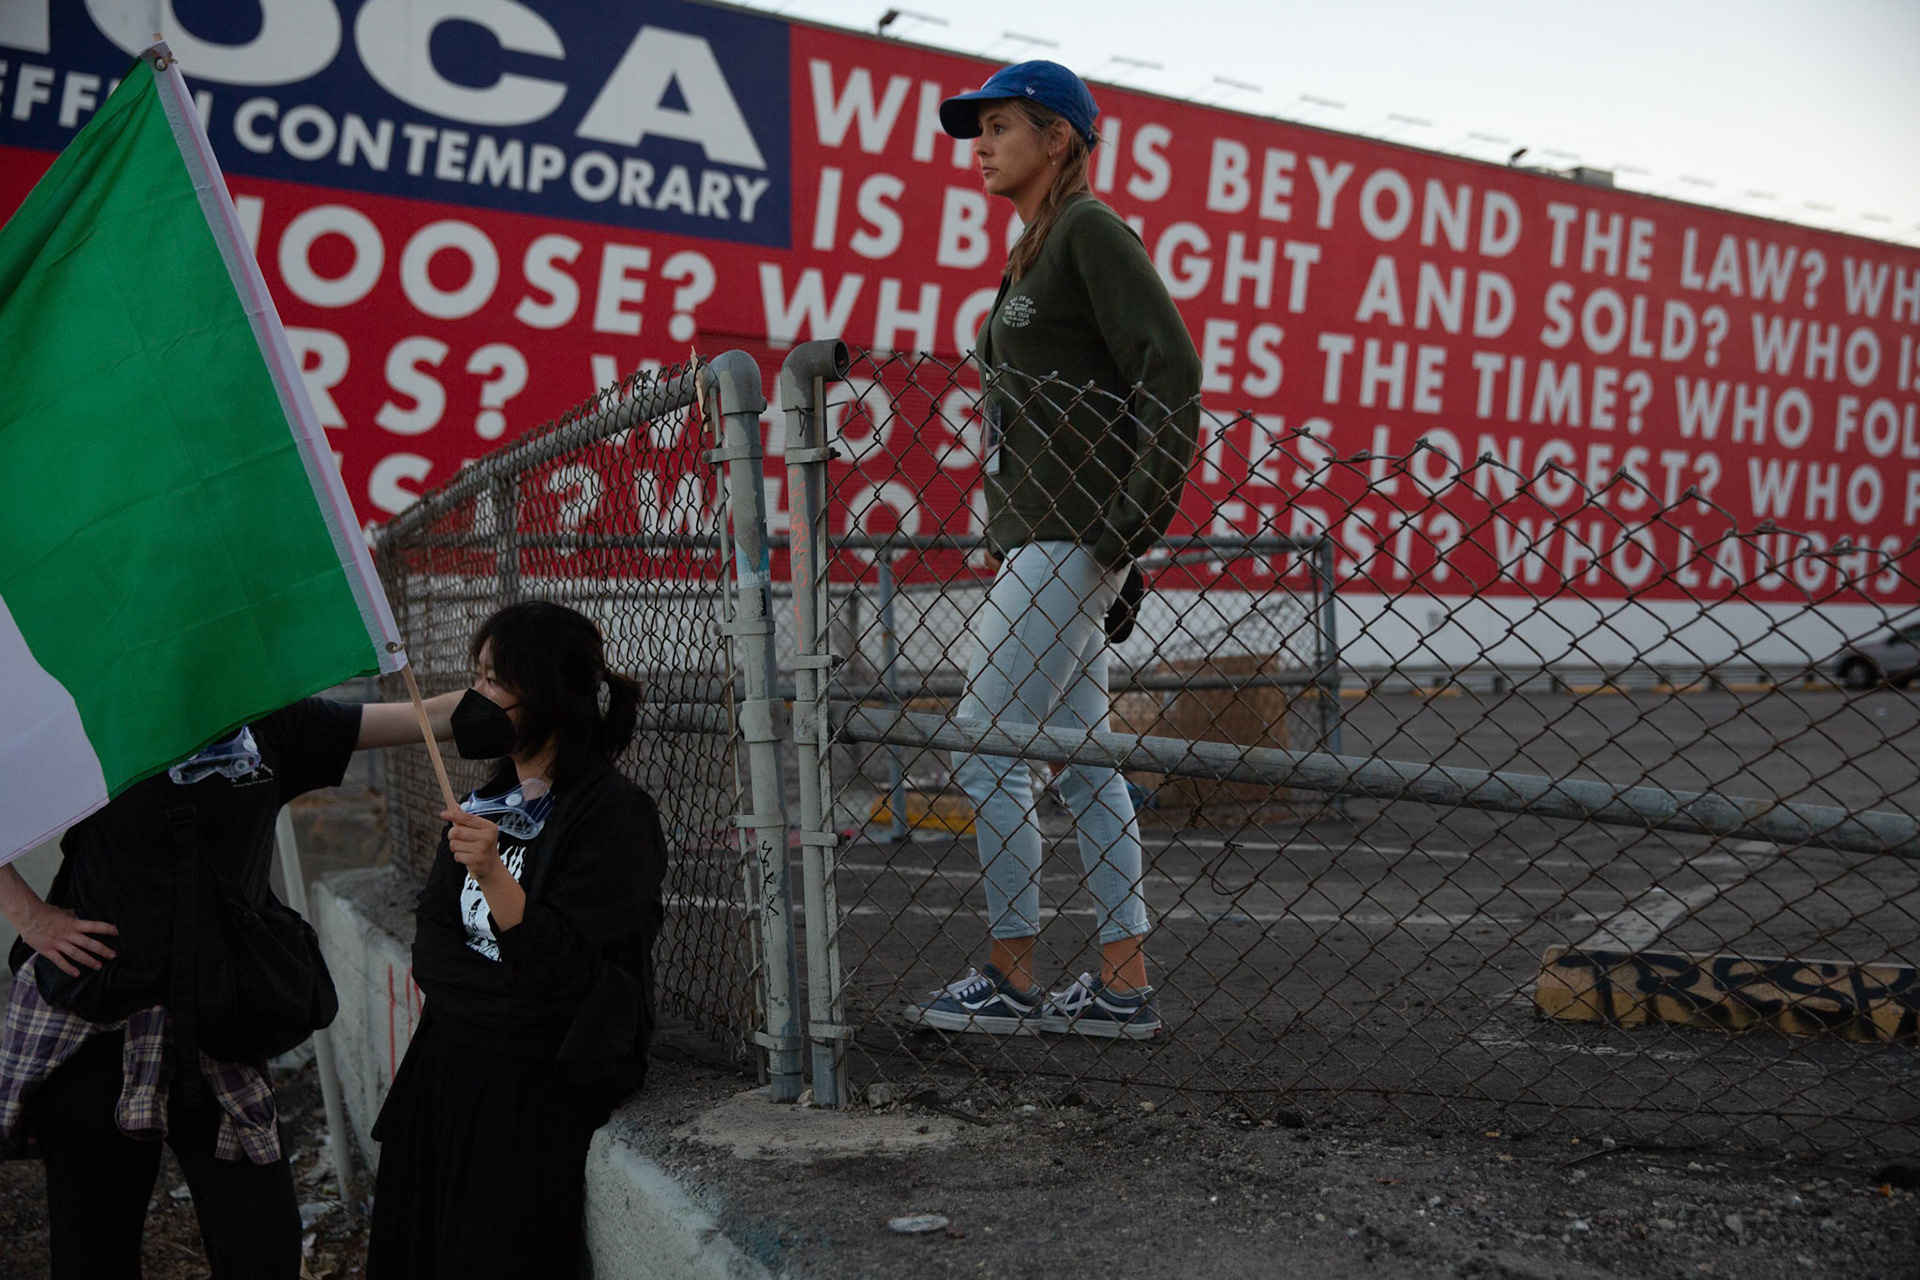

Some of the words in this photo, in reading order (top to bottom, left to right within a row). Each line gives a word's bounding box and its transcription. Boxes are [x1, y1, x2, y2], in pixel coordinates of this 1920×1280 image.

[0, 0, 767, 171] OCA
[233, 98, 769, 223] CONTEMPORARY
[808, 58, 981, 170] WH
[1094, 115, 1173, 203] IS
[1205, 136, 1523, 259] BEYOND
[1545, 202, 1656, 283] THE
[1679, 228, 1828, 309] LAW?
[1843, 256, 1920, 325] WH
[812, 166, 906, 260] IS
[936, 186, 1322, 315] BGHT
[1354, 254, 1517, 339] AND
[1540, 281, 1730, 368] SOLD?
[1751, 313, 1882, 387] WHO
[1897, 335, 1920, 393] I
[236, 196, 717, 342] OOSE?
[1200, 317, 1285, 399] ES
[1317, 332, 1448, 415] THE
[1471, 351, 1653, 435] TIME?
[1674, 376, 1813, 448] WHO
[1834, 395, 1920, 460] FOL
[283, 326, 529, 440] RS?
[934, 387, 1334, 490] STES
[1368, 424, 1722, 511] LONGEST?
[1748, 458, 1883, 524] WHO
[1493, 517, 1656, 588] WHO
[1677, 530, 1902, 594] LAUGHS
